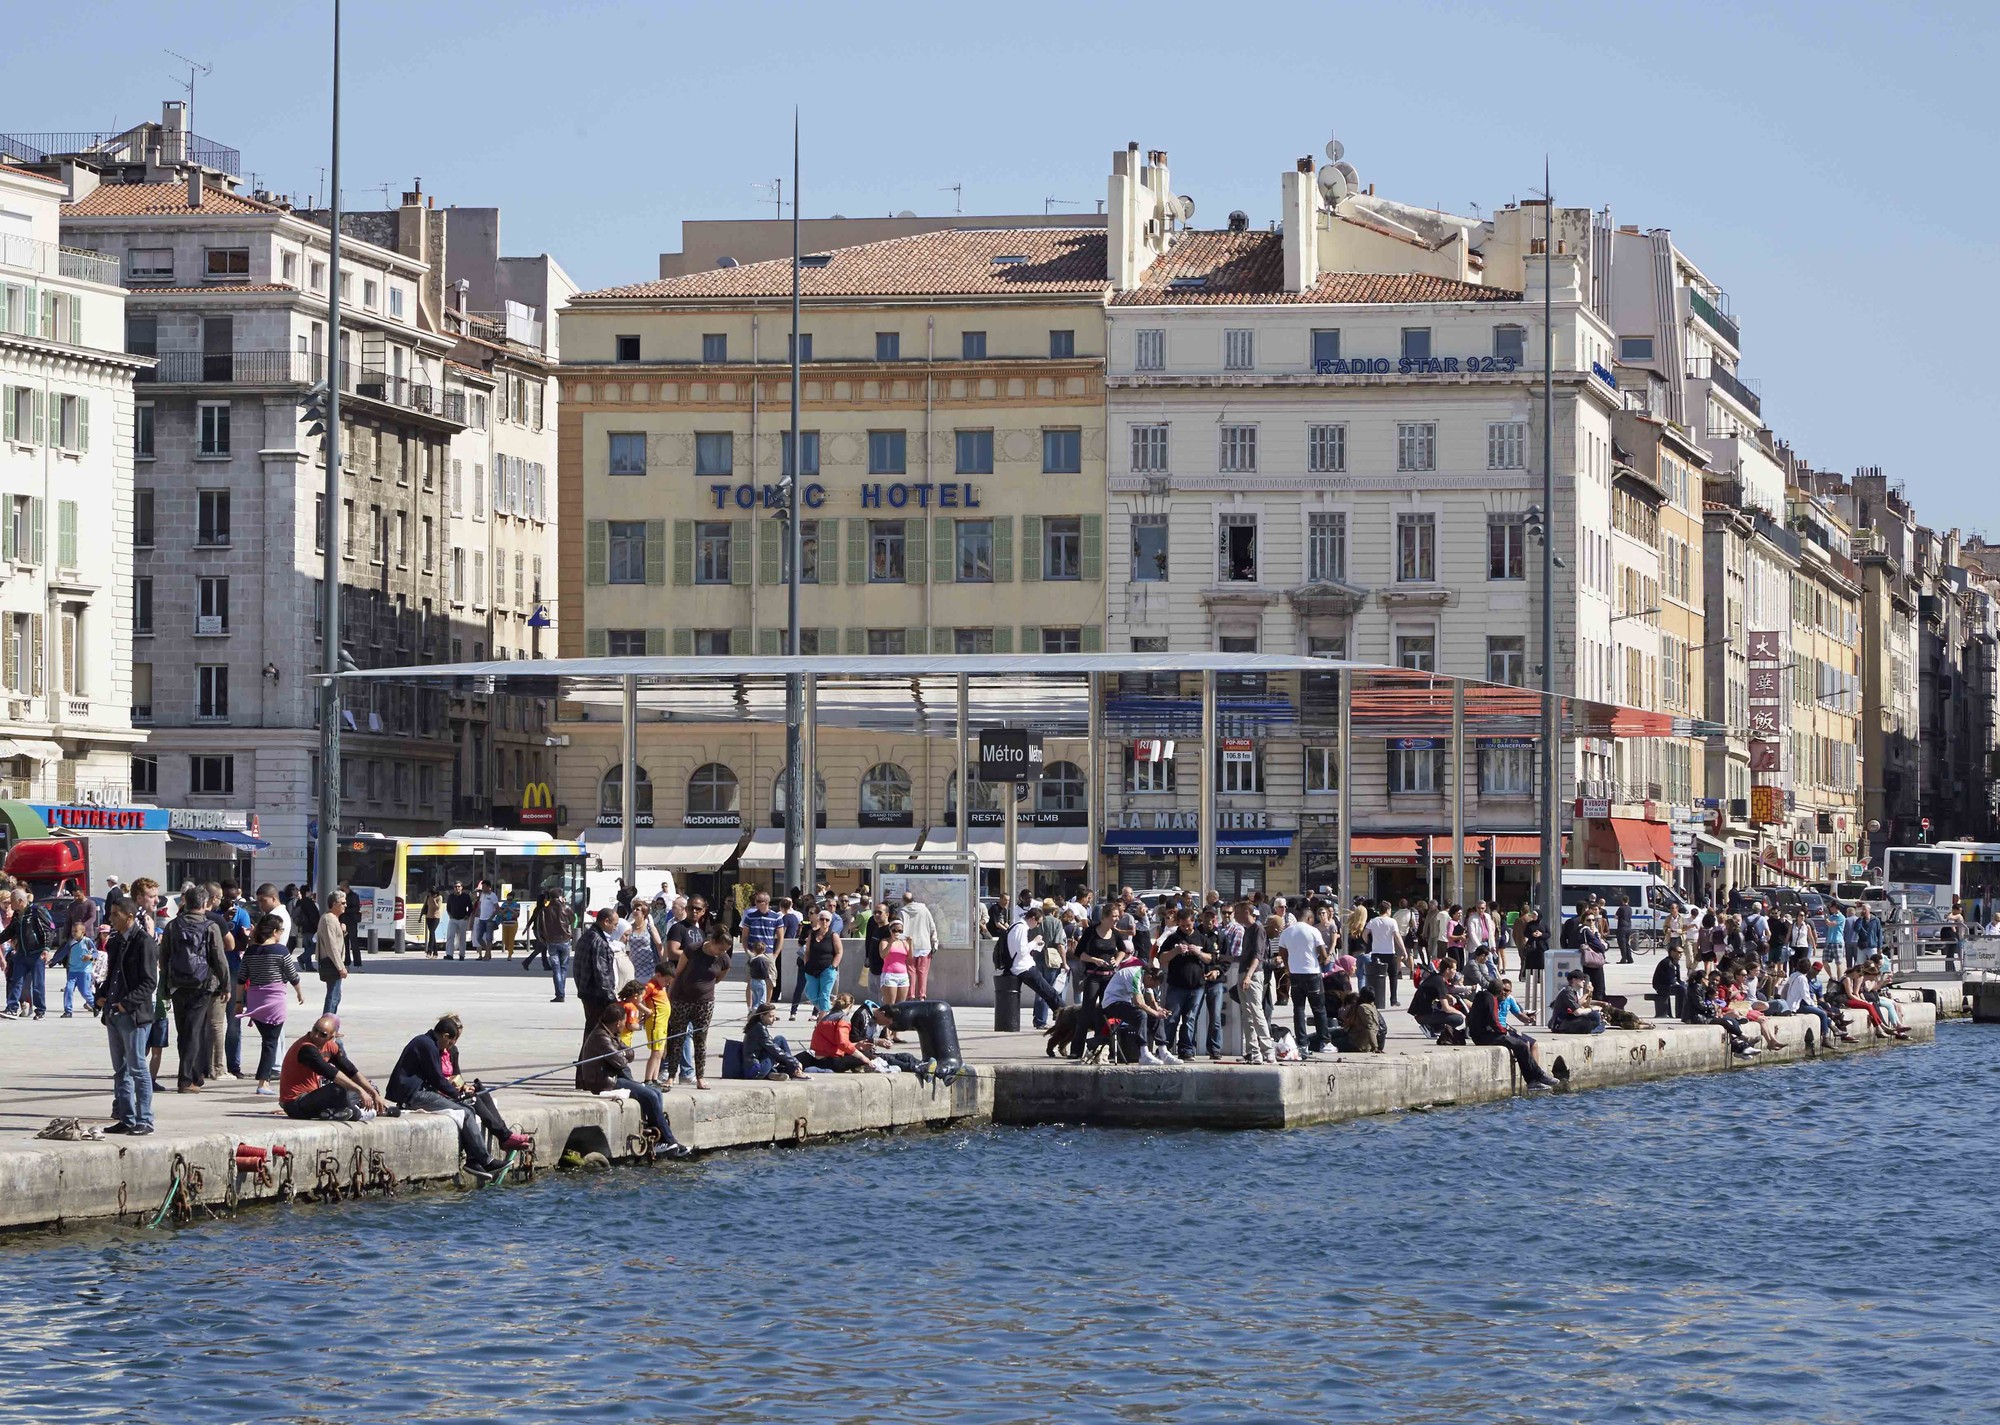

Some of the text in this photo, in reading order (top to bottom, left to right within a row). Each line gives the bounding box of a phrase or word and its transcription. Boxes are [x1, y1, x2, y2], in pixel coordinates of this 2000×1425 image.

[1317, 356, 1516, 375] RADIO STAR 92.3
[711, 483, 981, 509] TONC HOTEL
[983, 744, 1024, 762] Métro
[48, 808, 146, 829] L'ENTRECOTE
[596, 816, 654, 824] McDold's
[682, 816, 741, 825] McDonald's
[1038, 814, 1059, 822] LMB
[1118, 812, 1267, 829] LA MARIERE
